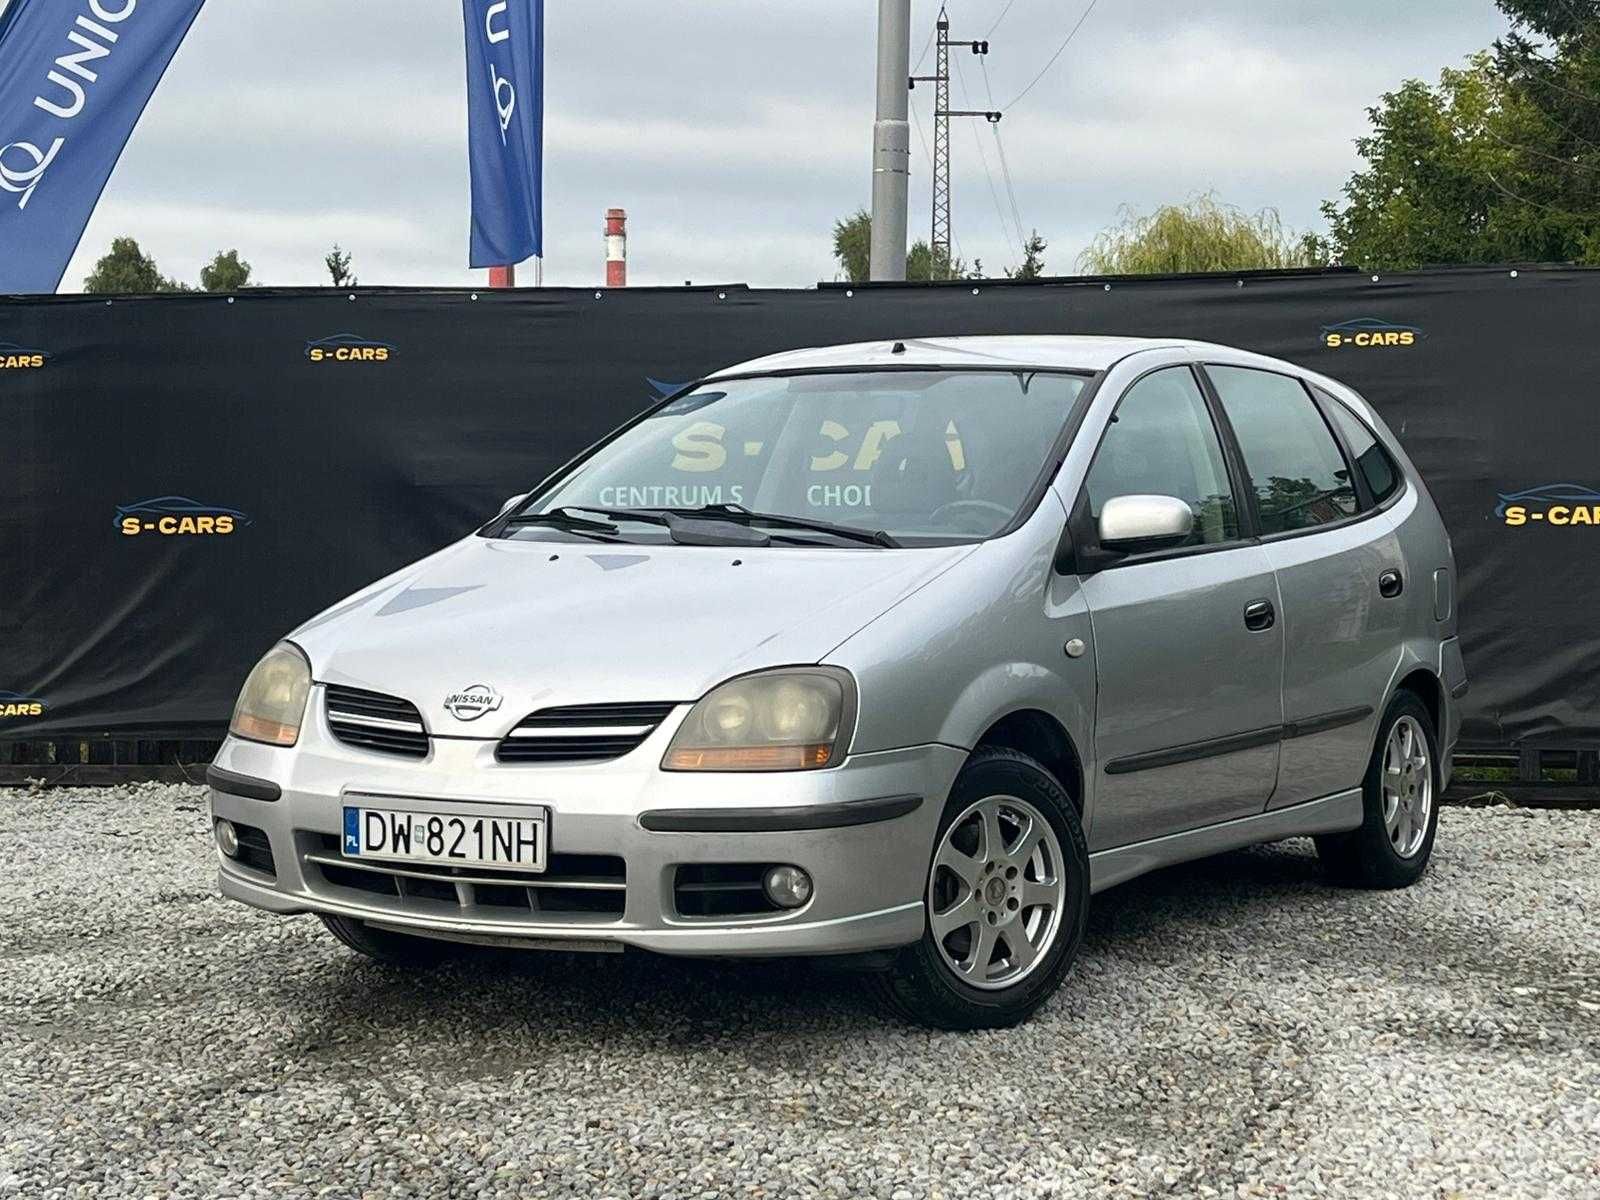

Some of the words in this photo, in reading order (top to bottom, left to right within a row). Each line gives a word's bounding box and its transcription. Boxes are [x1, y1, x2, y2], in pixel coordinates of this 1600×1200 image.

[600, 485, 723, 507] CENTRUM
[449, 694, 494, 705] NISSAN
[346, 835, 358, 848] PL
[365, 811, 412, 855] DW
[426, 816, 538, 864] 821NH
